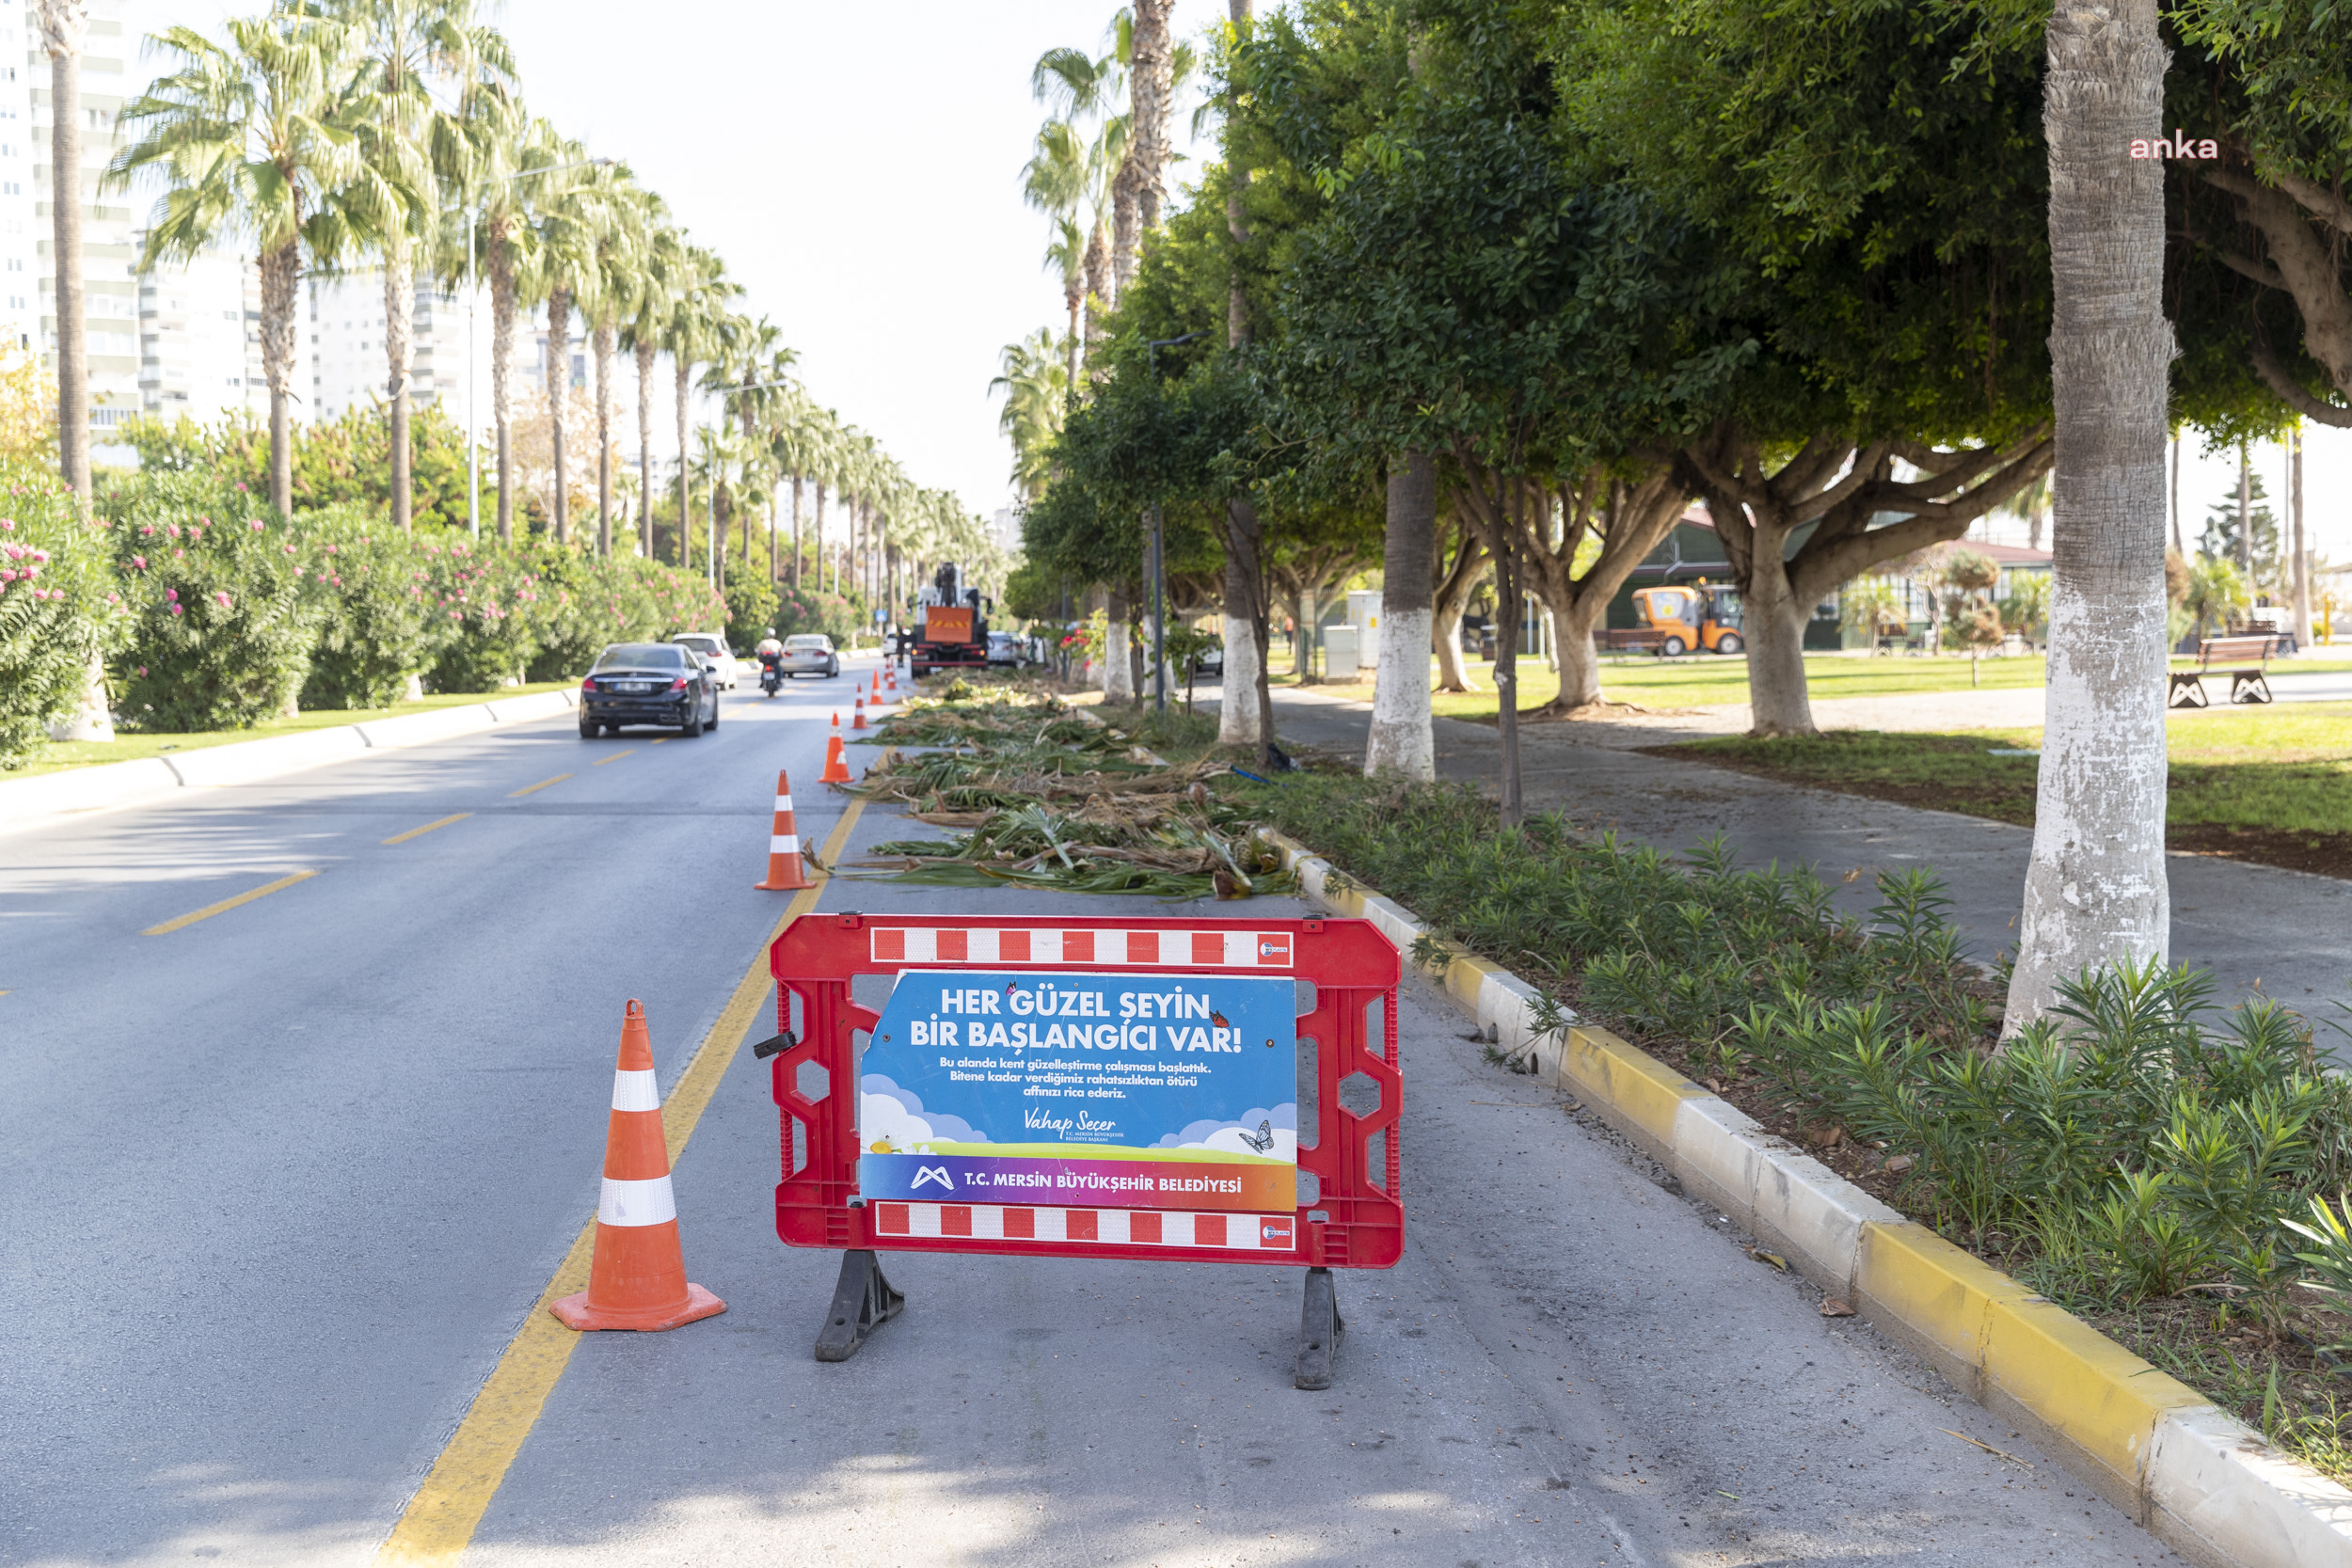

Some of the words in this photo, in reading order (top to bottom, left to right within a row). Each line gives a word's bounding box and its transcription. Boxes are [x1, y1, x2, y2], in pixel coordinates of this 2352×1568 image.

[942, 989, 1001, 1014] HER
[1009, 983, 1110, 1017] GÜZEL
[1119, 985, 1210, 1025] ŞEYİN
[911, 1013, 960, 1046] BİR
[968, 1022, 1156, 1056] BAŞLANGICI
[1166, 1026, 1242, 1053] VAR!
[940, 1056, 954, 1068] Bu
[957, 1056, 997, 1069] alanda
[999, 1057, 1025, 1069] kent
[1027, 1058, 1102, 1073] güzelleştirme
[1104, 1060, 1156, 1074] çalışması
[1158, 1061, 1212, 1075] başlattık.
[950, 1070, 985, 1082] Bitene
[988, 1070, 1022, 1082] kadar
[1025, 1072, 1084, 1085] verdiğimiz
[1087, 1073, 1164, 1085] rahatsızlıktan
[1167, 1075, 1198, 1086] ötürü
[1023, 1085, 1061, 1097] affınızı
[1064, 1086, 1085, 1098] rica
[1088, 1086, 1126, 1099] ederiz.
[1025, 1106, 1073, 1140] Vahap
[1076, 1110, 1116, 1132] Seçer
[964, 1172, 990, 1186] T.C.
[993, 1171, 1052, 1187] MERSİN
[1057, 1171, 1154, 1193] BÜYÜKŞEHİR
[1159, 1175, 1242, 1193] BELEDİYESİ
